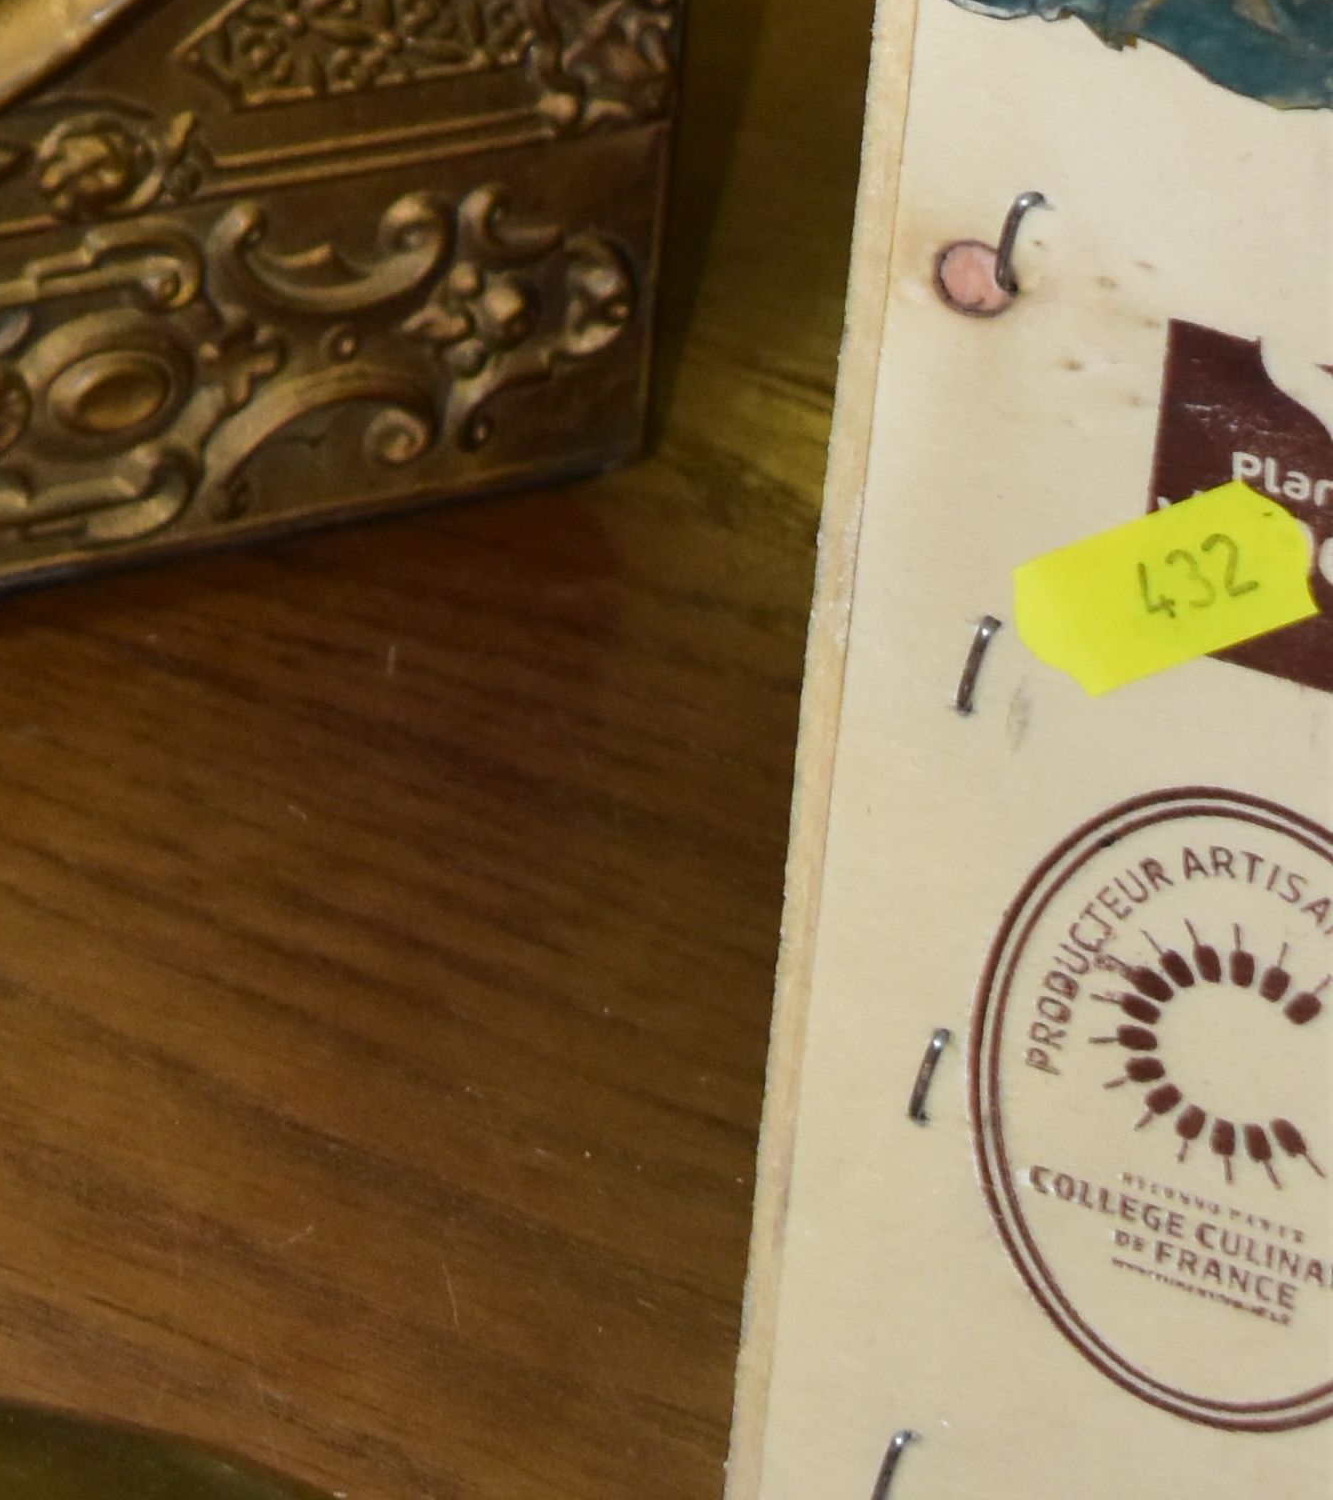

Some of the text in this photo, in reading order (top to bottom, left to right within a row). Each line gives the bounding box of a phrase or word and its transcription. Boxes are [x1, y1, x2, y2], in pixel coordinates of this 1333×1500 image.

[1137, 532, 1260, 619] 432
[1026, 844, 1333, 1075] PRODUCTEUR ARTISA
[1029, 1163, 1333, 1290] COLLEGE CULINA
[1154, 1239, 1298, 1311] FRANCE
